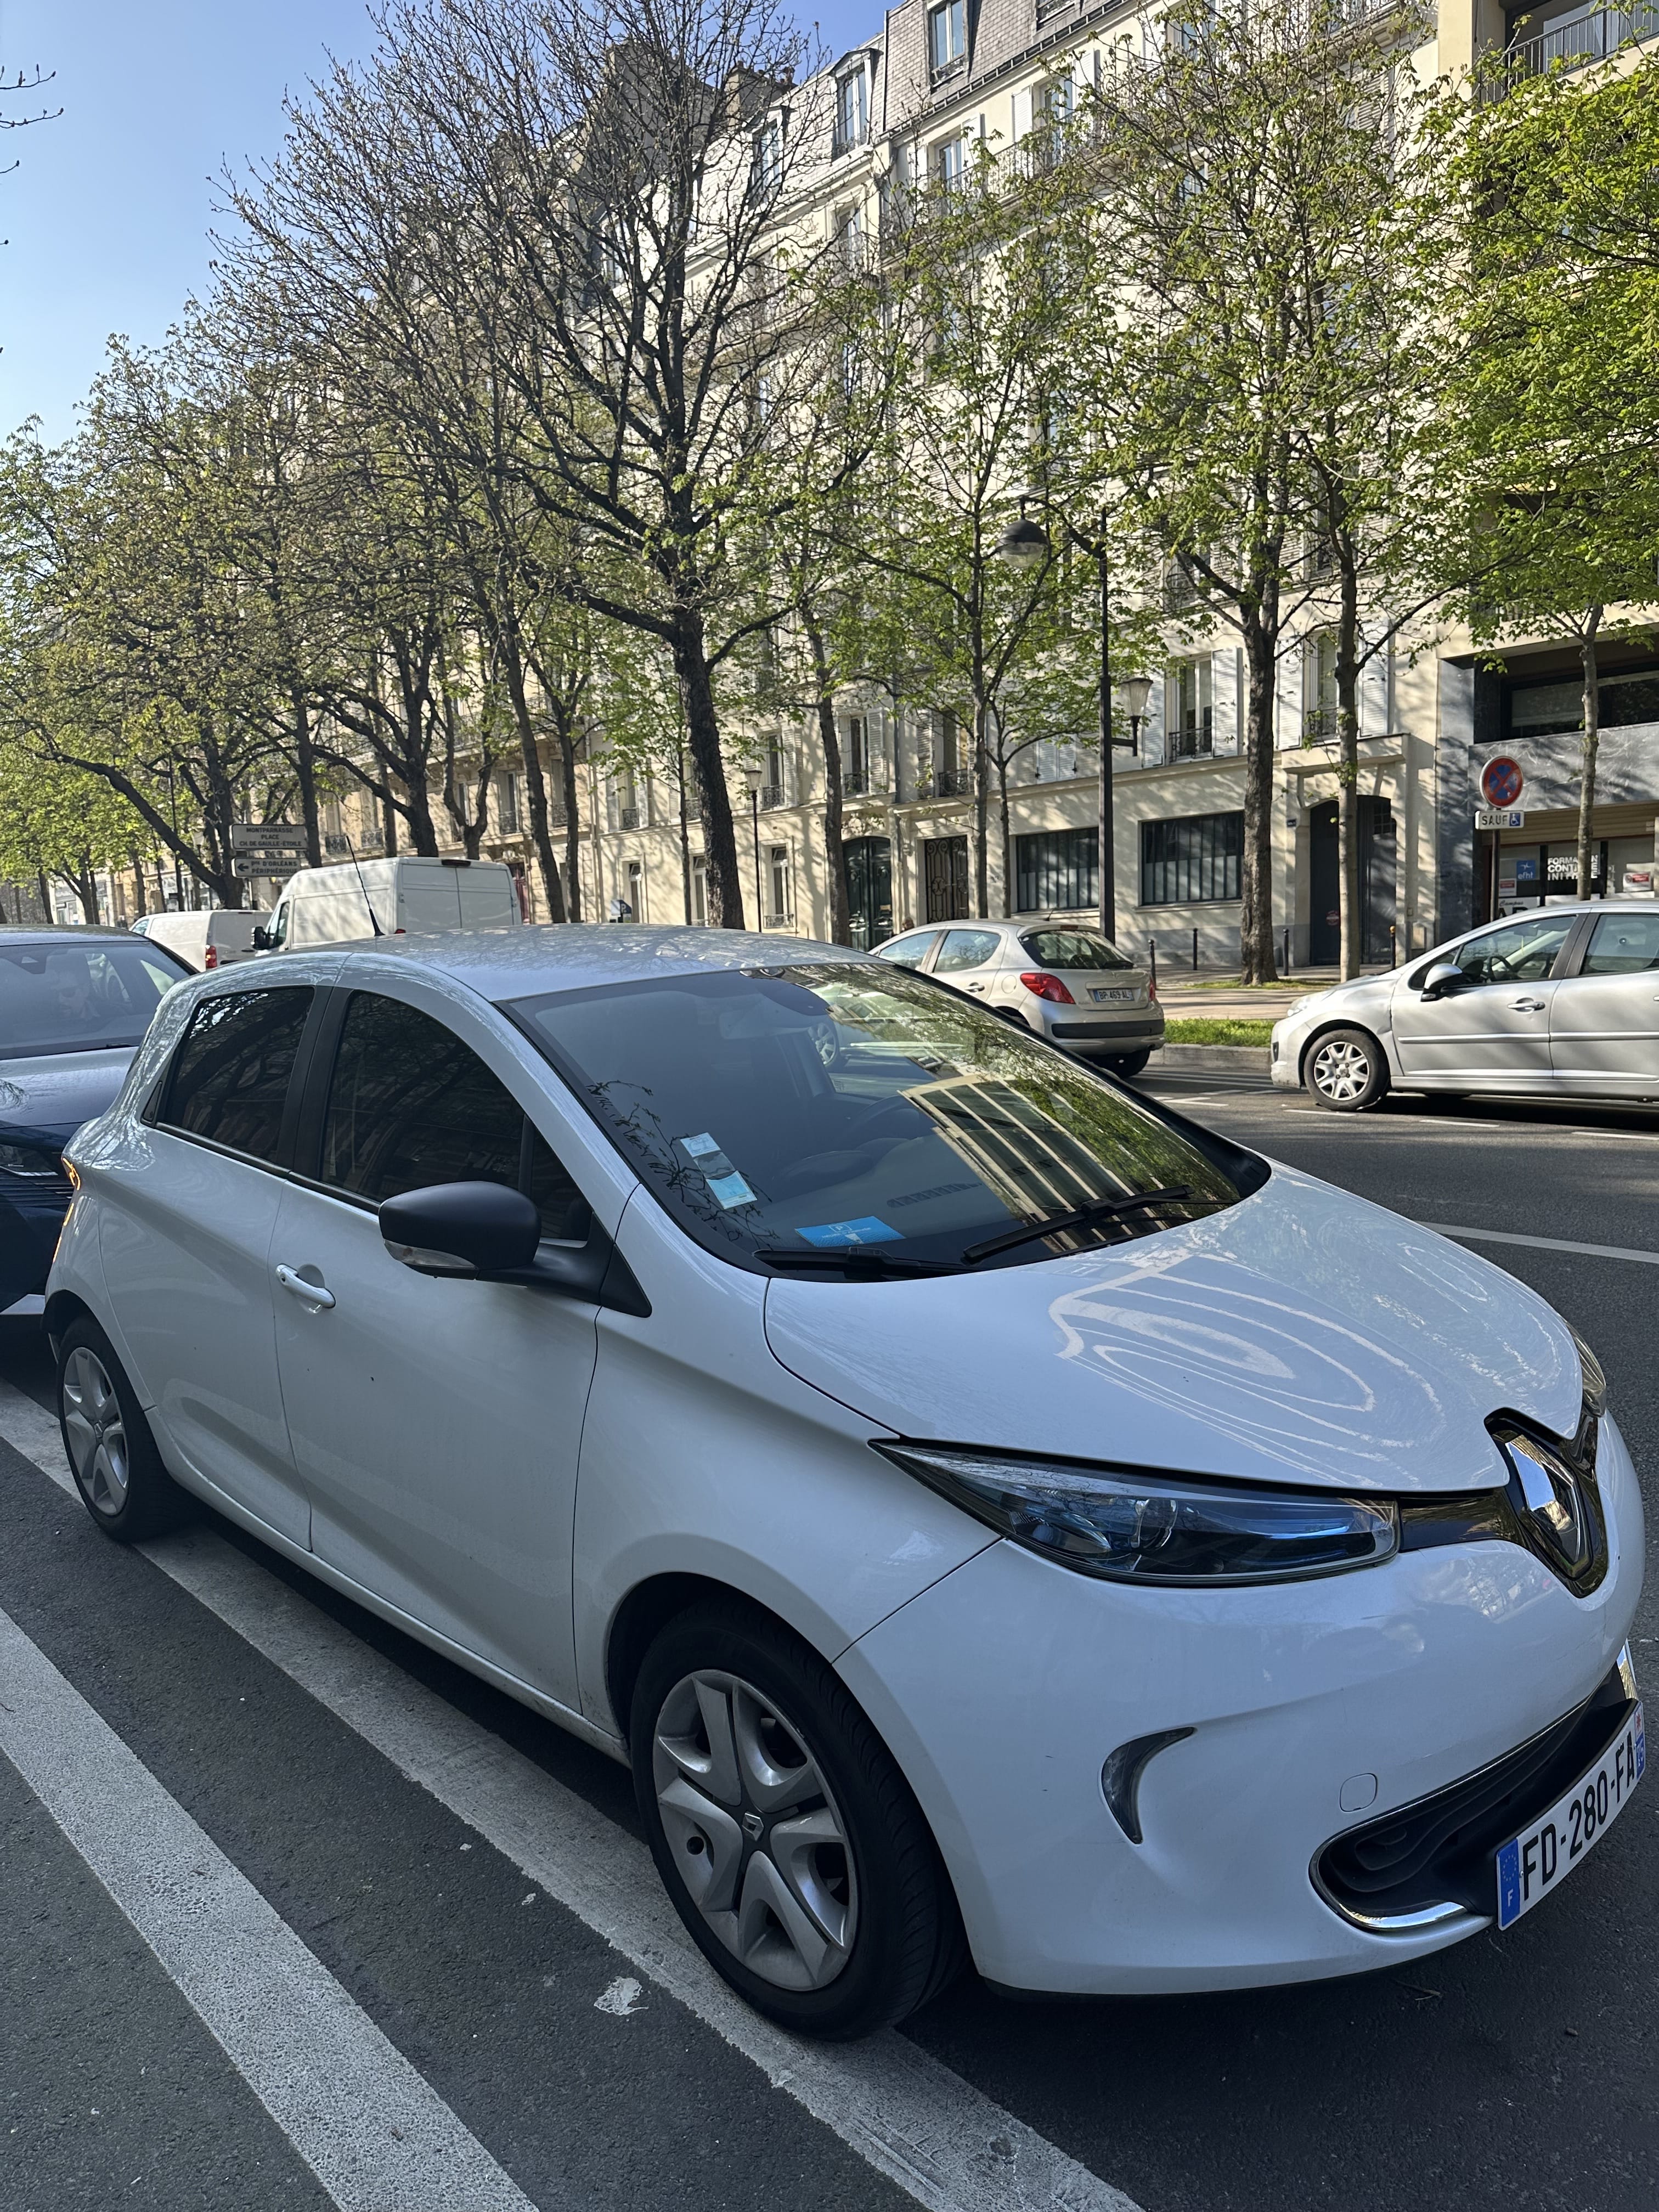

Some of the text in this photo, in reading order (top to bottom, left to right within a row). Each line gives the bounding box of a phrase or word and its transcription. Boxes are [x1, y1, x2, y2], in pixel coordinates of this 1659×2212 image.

[1482, 815, 1508, 825] SAUF
[1522, 1731, 1635, 1901] FD-280-FA
[1507, 1889, 1514, 1908] F
